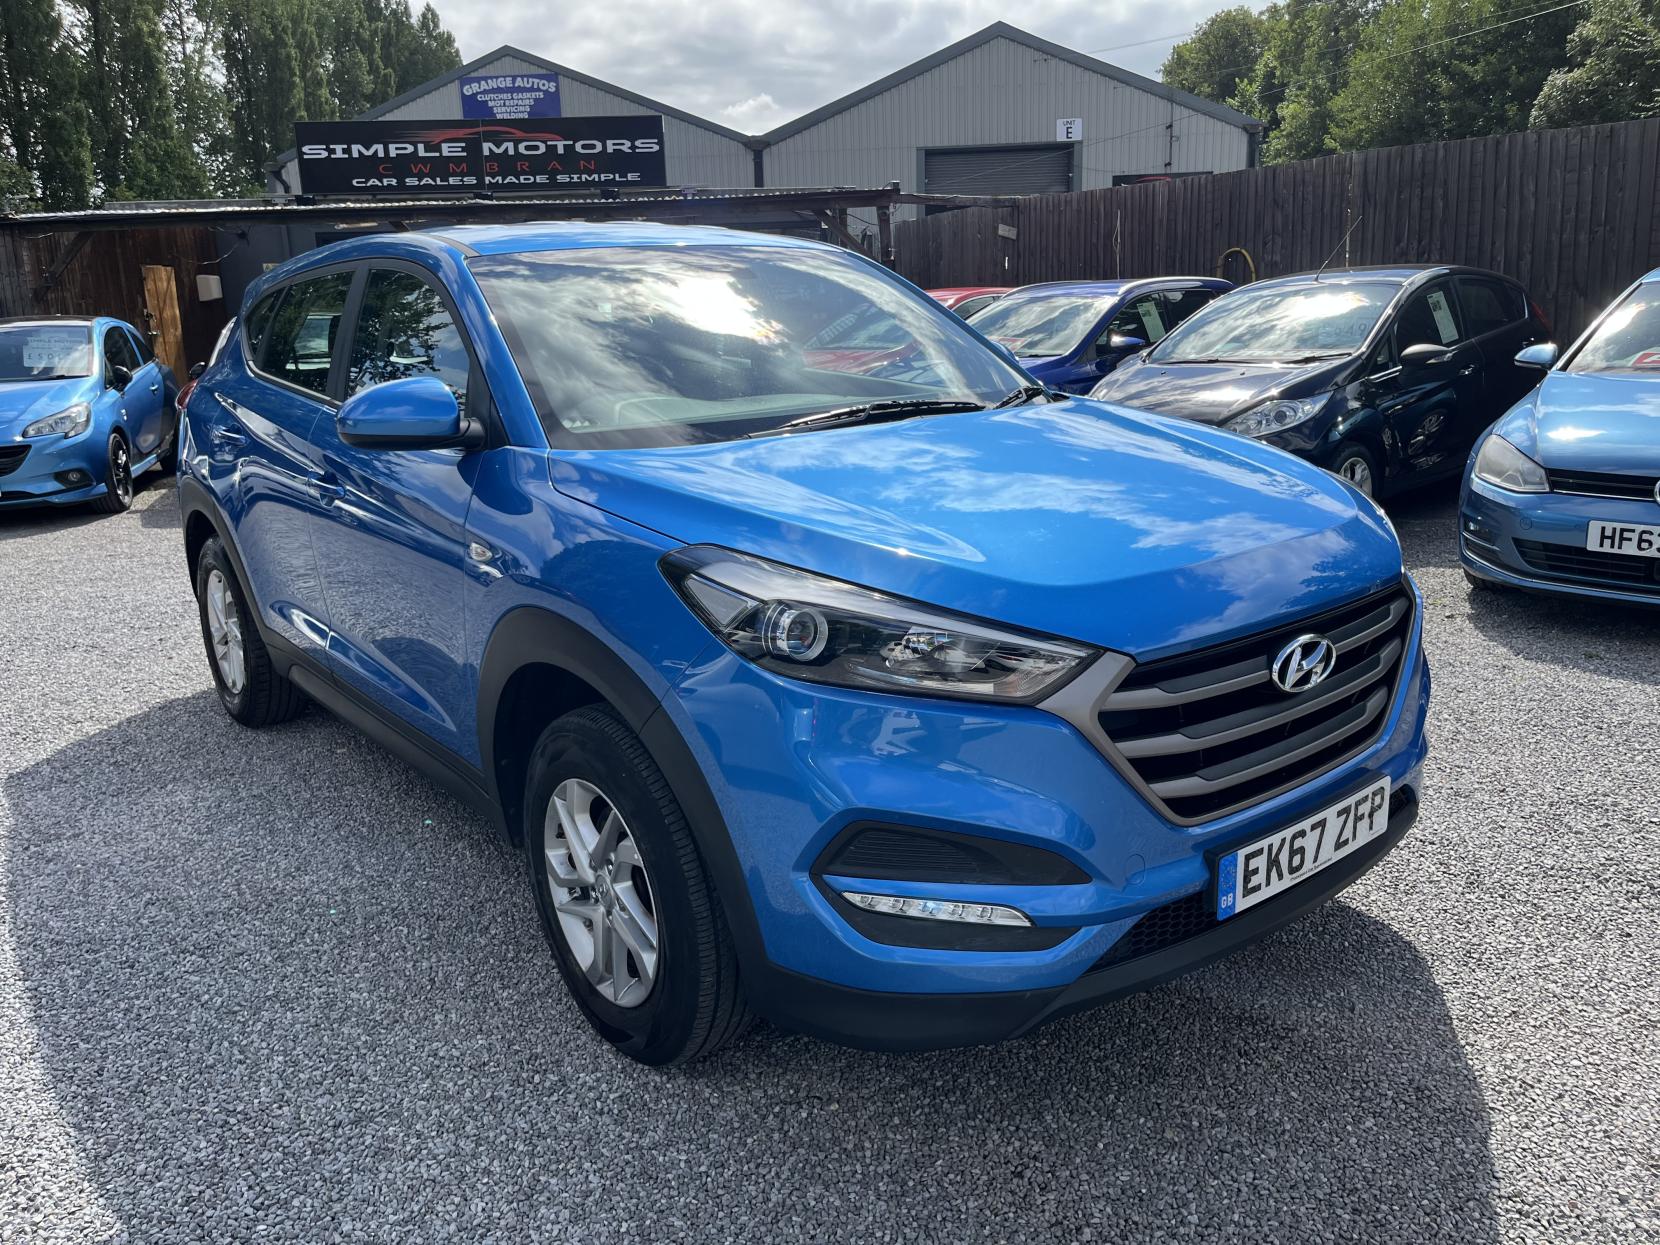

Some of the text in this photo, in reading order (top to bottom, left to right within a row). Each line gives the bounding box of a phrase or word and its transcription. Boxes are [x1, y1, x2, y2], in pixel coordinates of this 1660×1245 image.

[463, 77, 557, 96] GRANGE AUTOS
[477, 91, 544, 101] CLUTCHES GASKETS
[1066, 126, 1073, 139] E
[302, 138, 660, 159] SIMPLE MOTORS
[378, 159, 596, 175] CWMBRAN
[352, 172, 641, 187] CAR SALES MADE SIMPLE
[1599, 526, 1660, 554] HF6
[1241, 785, 1386, 899] EK67 ZFP
[1221, 893, 1233, 909] GB
